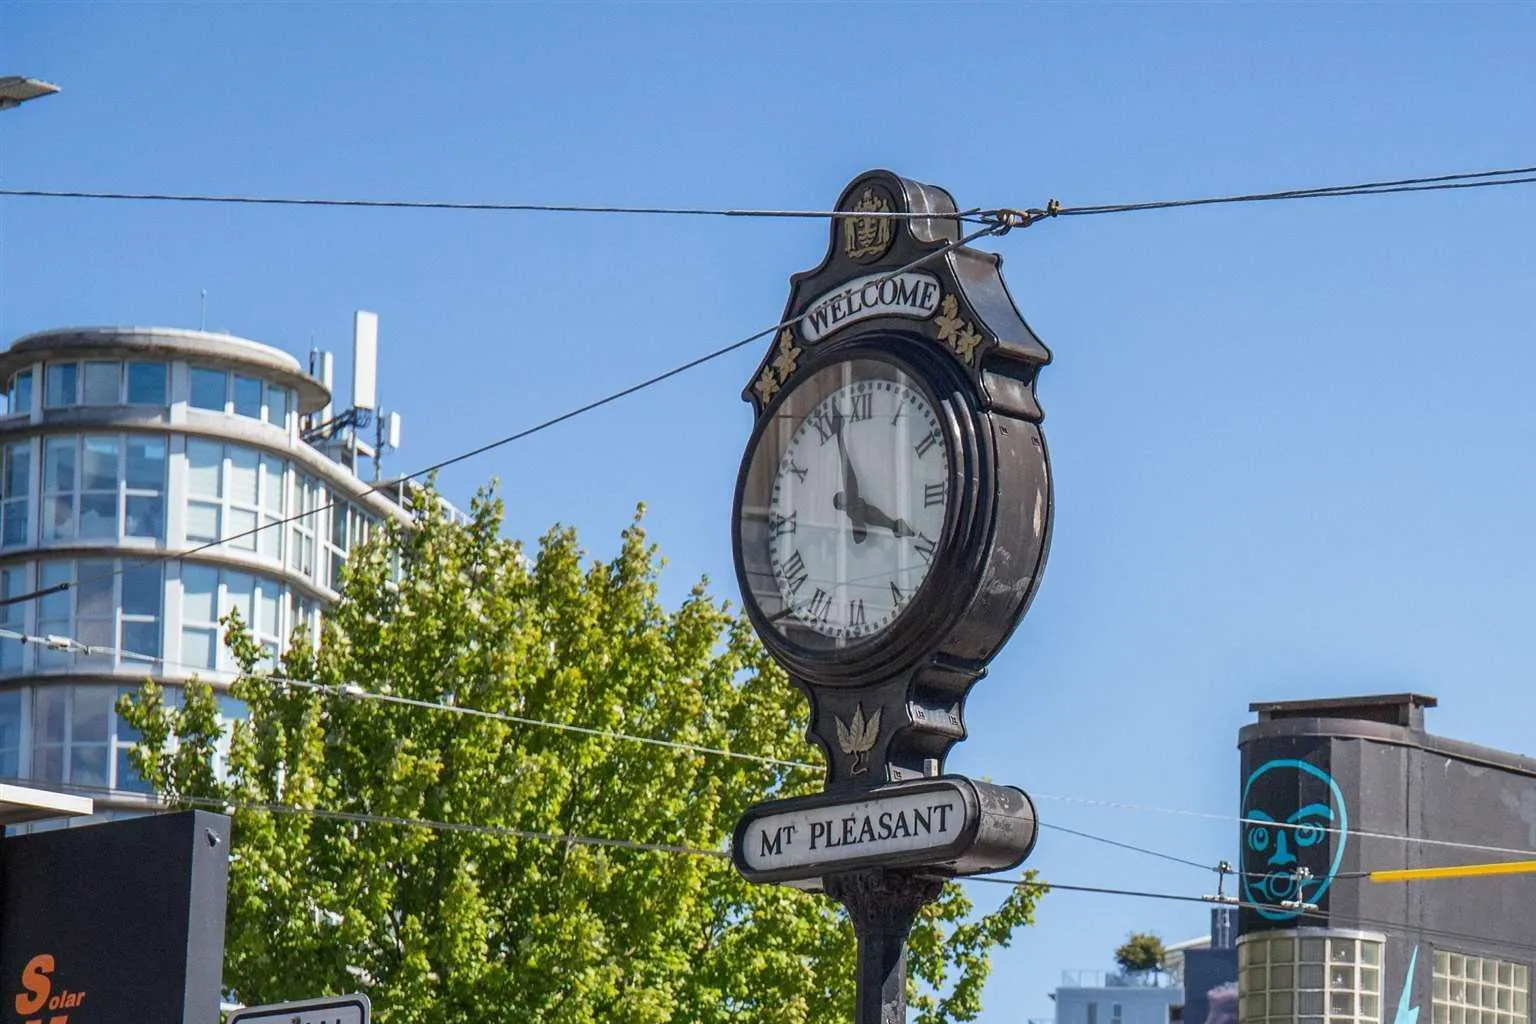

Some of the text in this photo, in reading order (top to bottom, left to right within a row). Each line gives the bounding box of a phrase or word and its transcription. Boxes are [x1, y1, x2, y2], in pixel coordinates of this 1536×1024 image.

[808, 278, 937, 335] WELCOME
[809, 804, 953, 850] PLEASANT
[15, 953, 86, 1015] Solar
